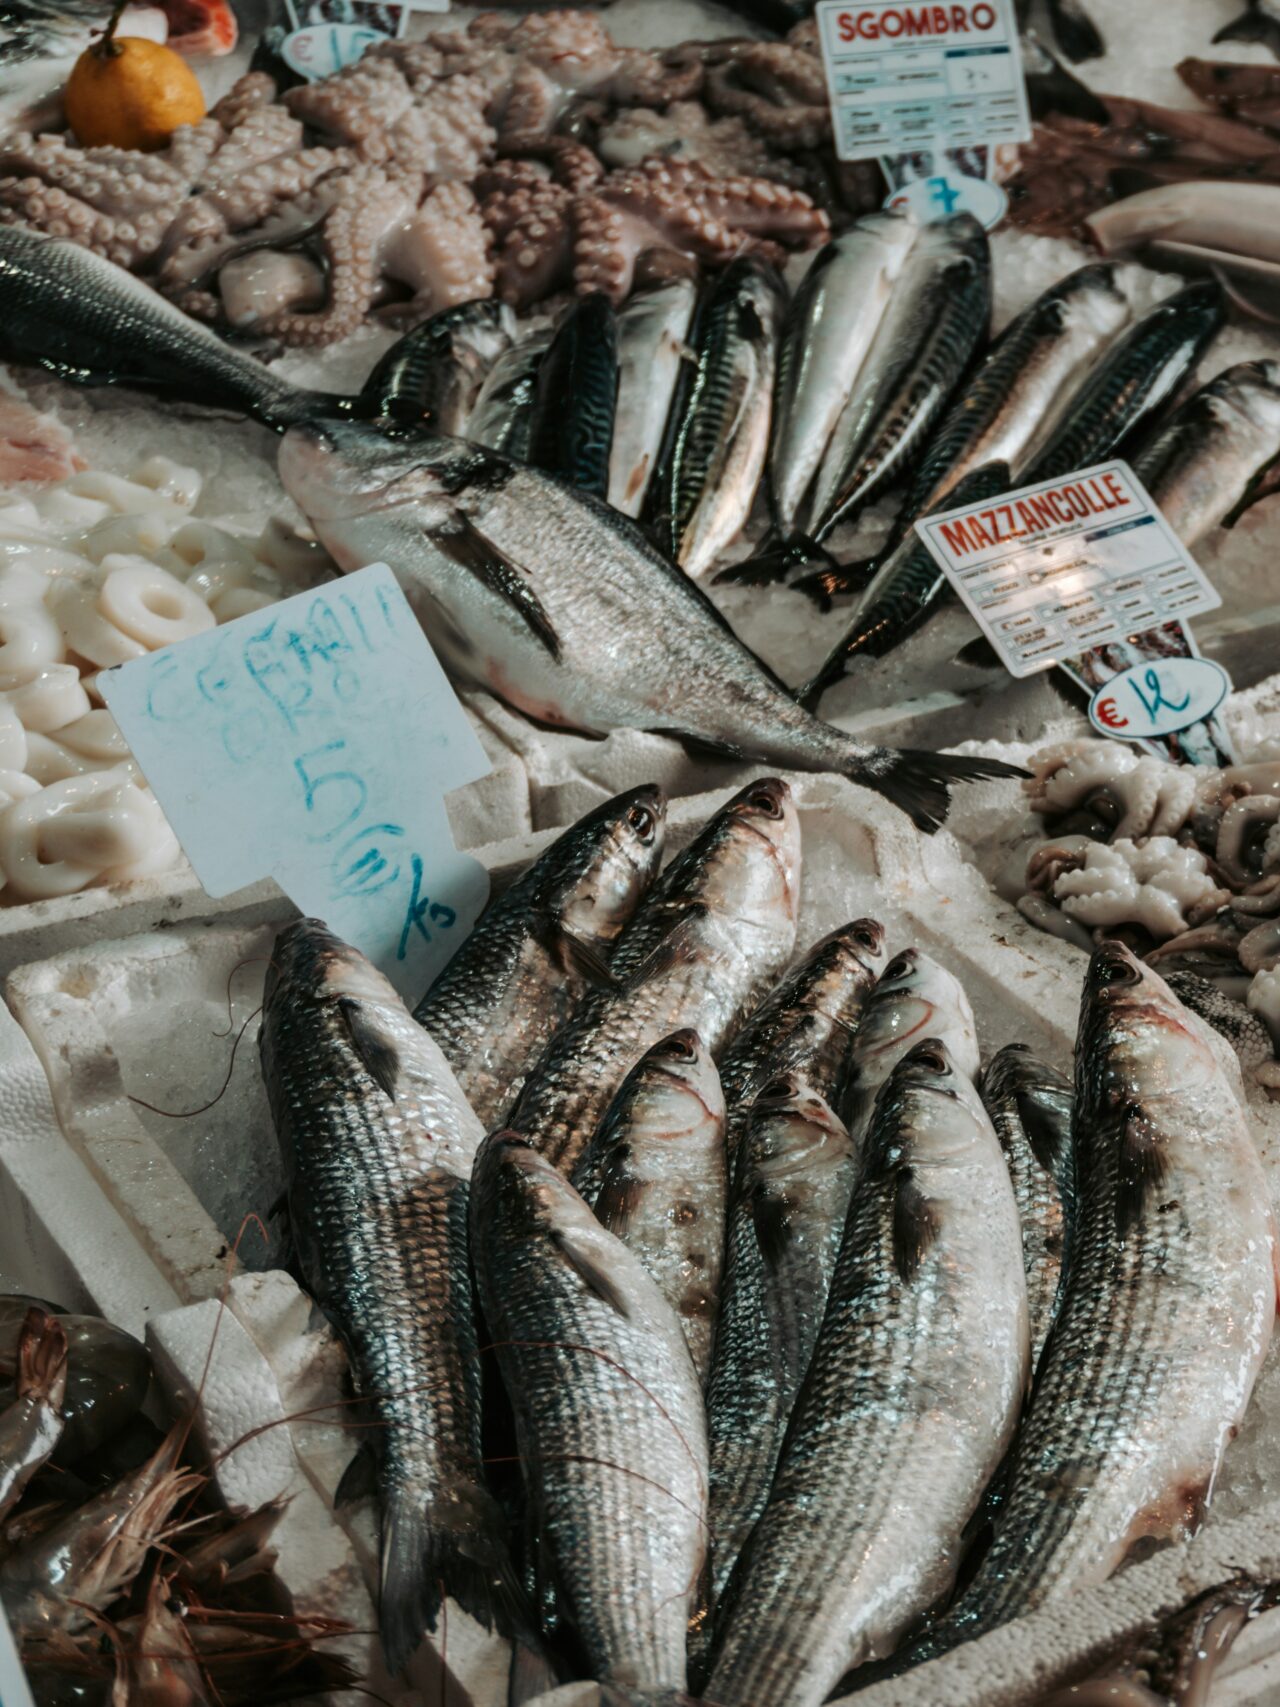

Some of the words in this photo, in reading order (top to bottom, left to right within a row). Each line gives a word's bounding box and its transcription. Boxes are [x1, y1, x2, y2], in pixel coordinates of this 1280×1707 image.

[837, 3, 995, 42] SGOMBRO
[938, 473, 1131, 558] MAZZANCOLLE
[1096, 697, 1129, 729] €
